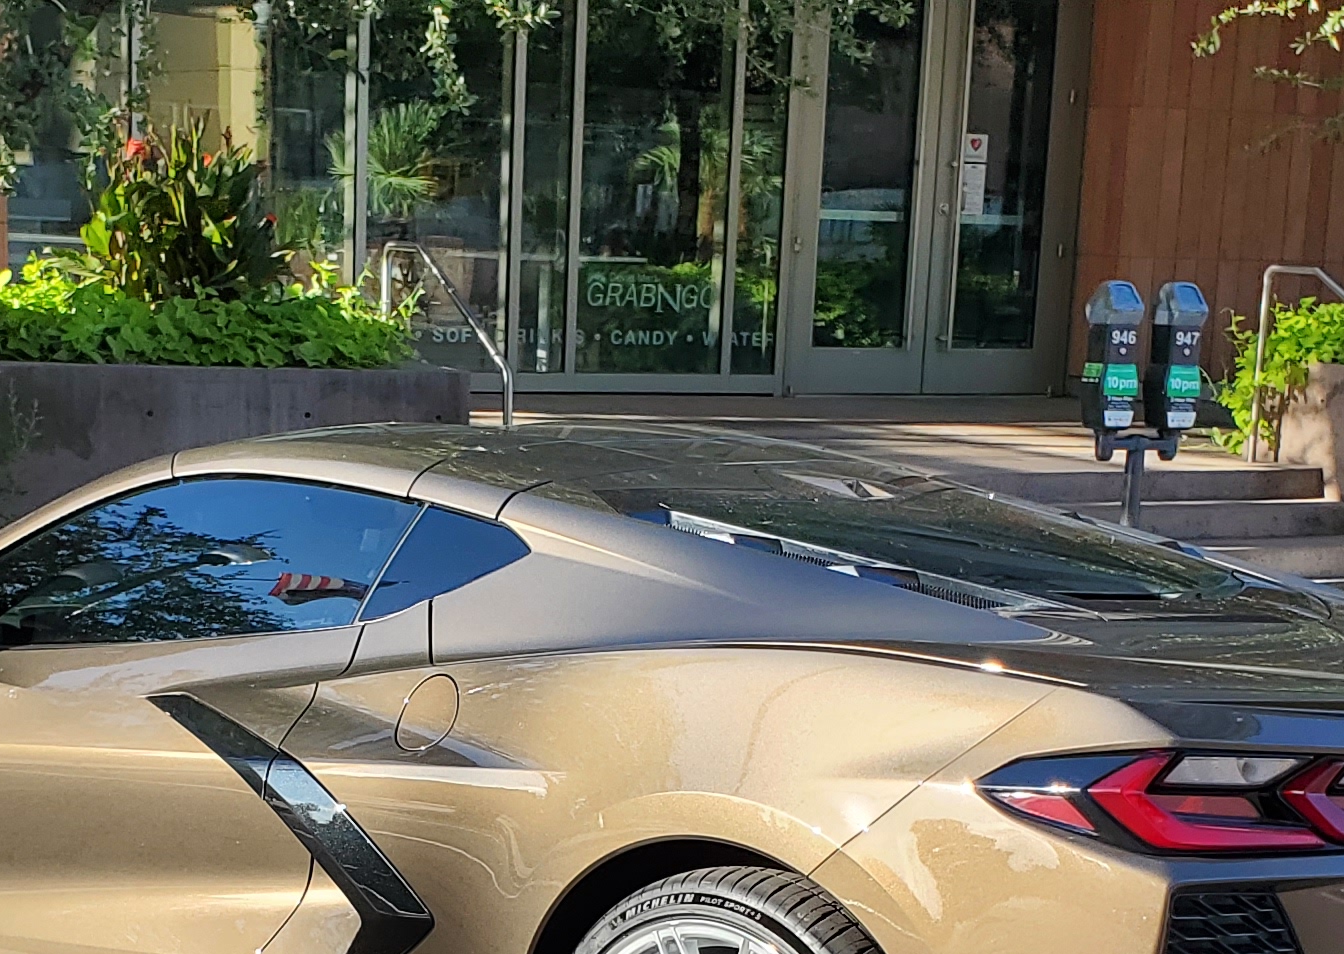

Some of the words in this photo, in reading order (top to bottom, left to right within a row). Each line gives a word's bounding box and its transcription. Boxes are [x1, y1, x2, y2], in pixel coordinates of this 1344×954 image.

[432, 328, 481, 344] SOF
[496, 328, 585, 345] DRIKS
[610, 329, 678, 346] CANDY
[1111, 330, 1137, 345] 946
[1175, 331, 1201, 347] 947
[1107, 375, 1138, 391] 10pm
[1170, 376, 1200, 393] 10pm
[625, 893, 695, 921] MICHELIN
